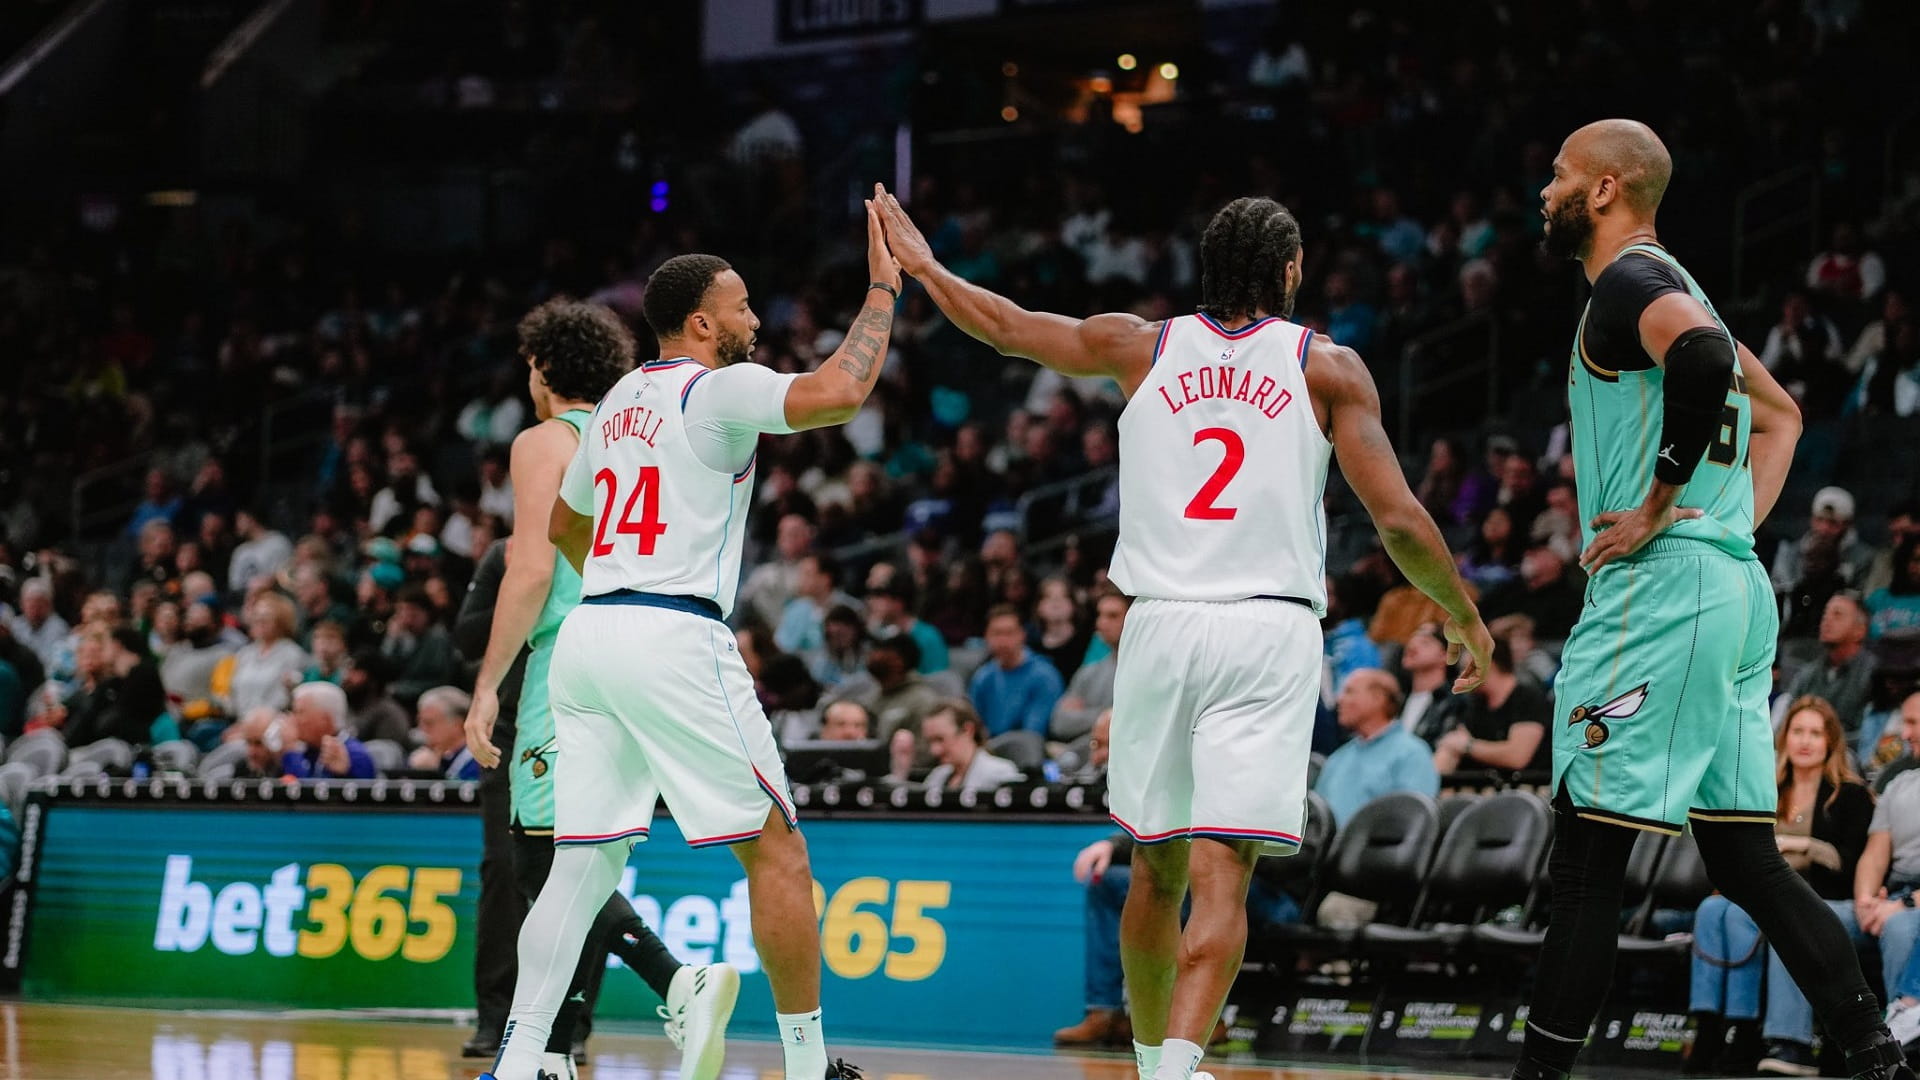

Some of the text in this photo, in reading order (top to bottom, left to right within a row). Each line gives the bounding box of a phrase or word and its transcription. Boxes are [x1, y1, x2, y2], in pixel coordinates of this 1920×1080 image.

[1159, 366, 1292, 419] LEONARD
[602, 406, 663, 449] POWELL
[1184, 428, 1245, 520] 2
[593, 466, 667, 557] 24
[154, 854, 462, 963] bet365
[605, 866, 951, 981] et65
[1271, 1005, 1287, 1024] 2
[1379, 1011, 1395, 1029] 3
[1489, 1012, 1504, 1031] 4
[1606, 1020, 1622, 1039] 5
[1632, 1012, 1687, 1028] UTILITY
